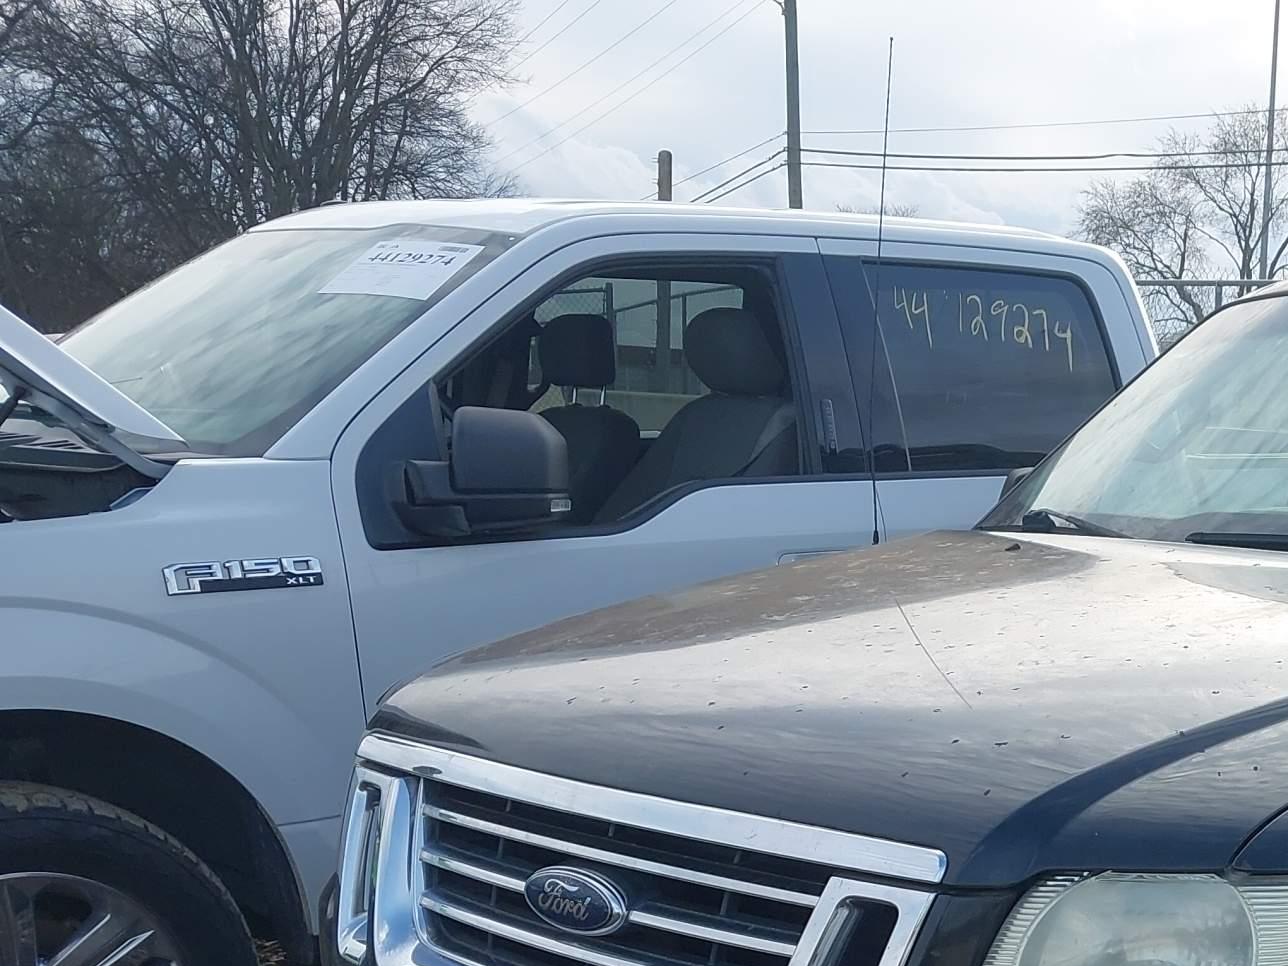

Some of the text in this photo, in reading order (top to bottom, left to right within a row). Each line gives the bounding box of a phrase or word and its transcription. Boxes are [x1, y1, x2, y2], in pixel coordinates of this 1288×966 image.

[368, 252, 457, 266] 44129274
[894, 285, 1074, 374] 44 129274
[286, 575, 317, 585] XLT
[538, 878, 592, 921] Ford
